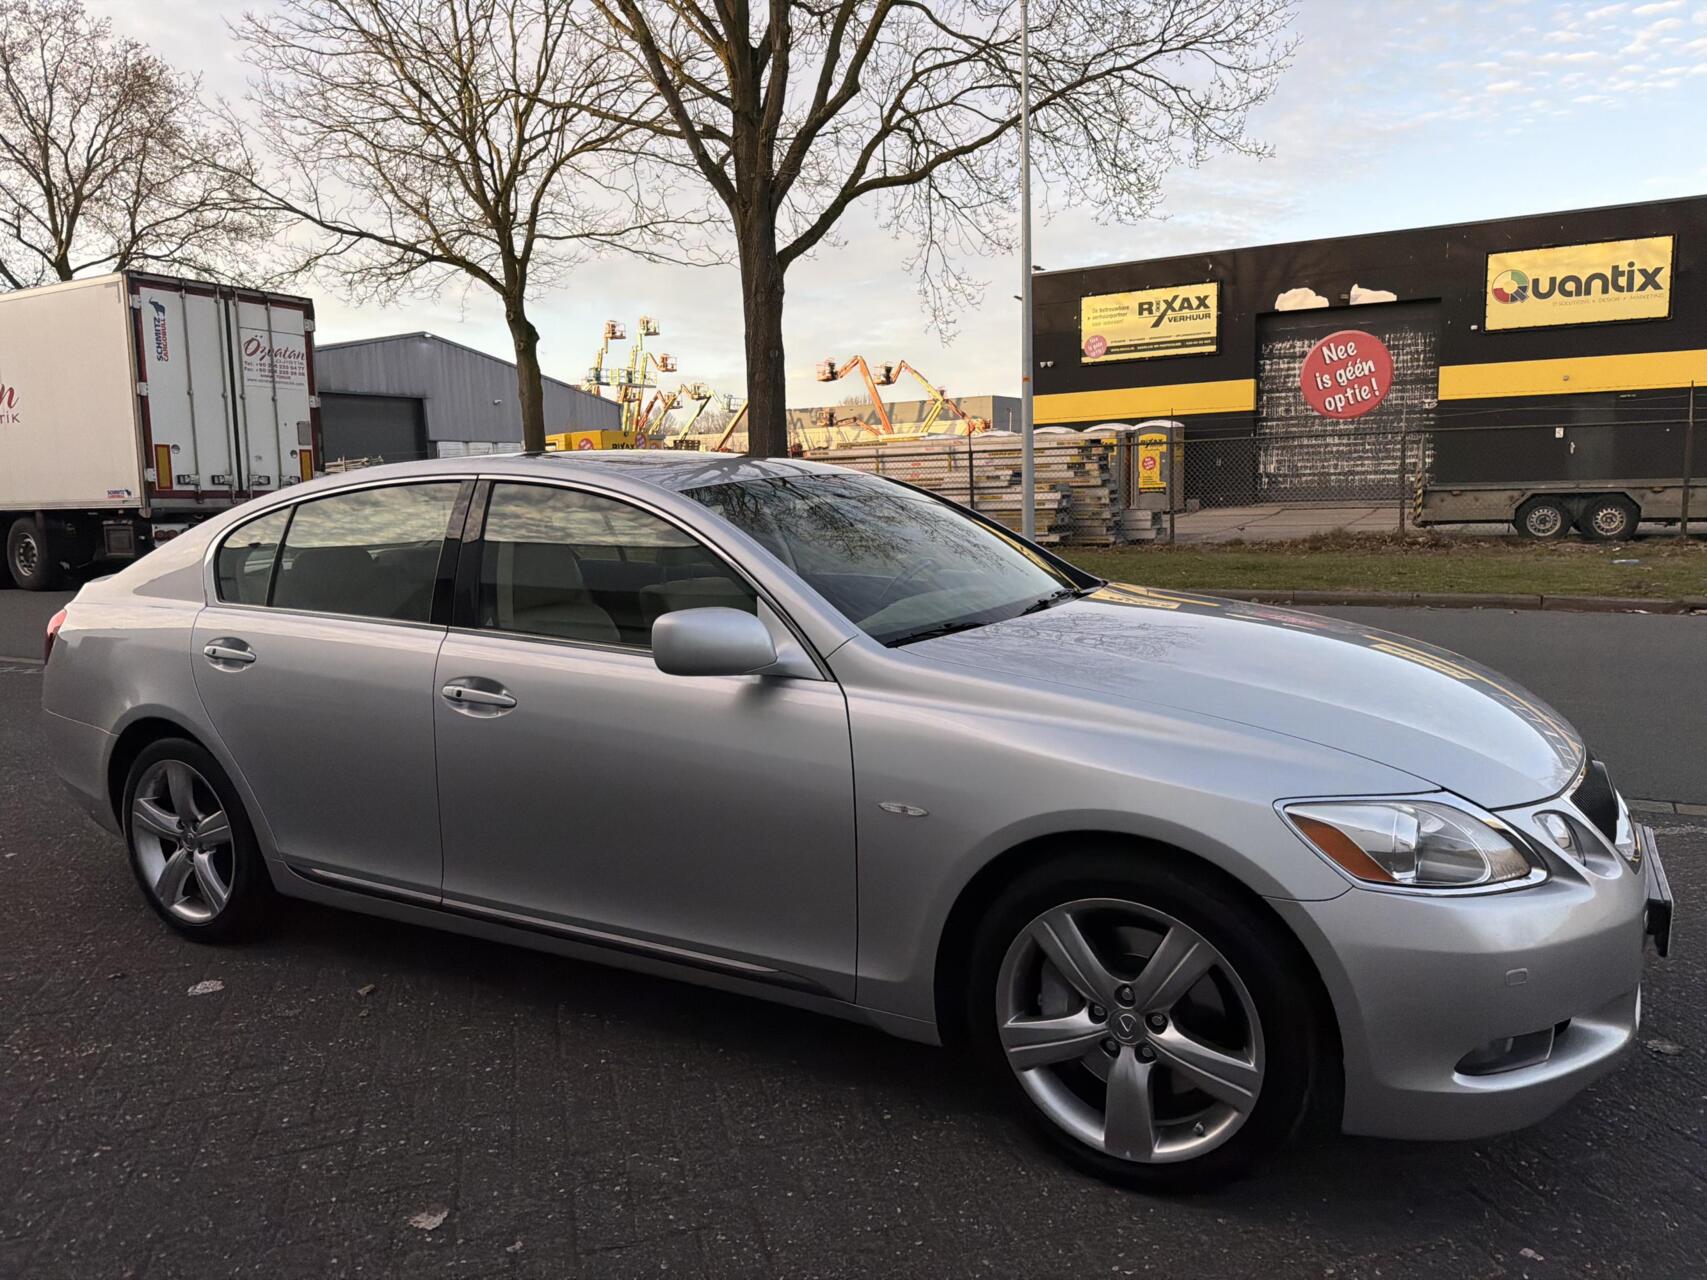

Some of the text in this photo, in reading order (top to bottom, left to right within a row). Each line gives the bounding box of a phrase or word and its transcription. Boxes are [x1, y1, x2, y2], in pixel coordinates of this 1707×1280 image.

[1168, 312, 1211, 323] VERHUUR
[153, 316, 164, 362] SCHMITZ
[1322, 341, 1357, 364] Nee
[1315, 358, 1376, 390] is géén
